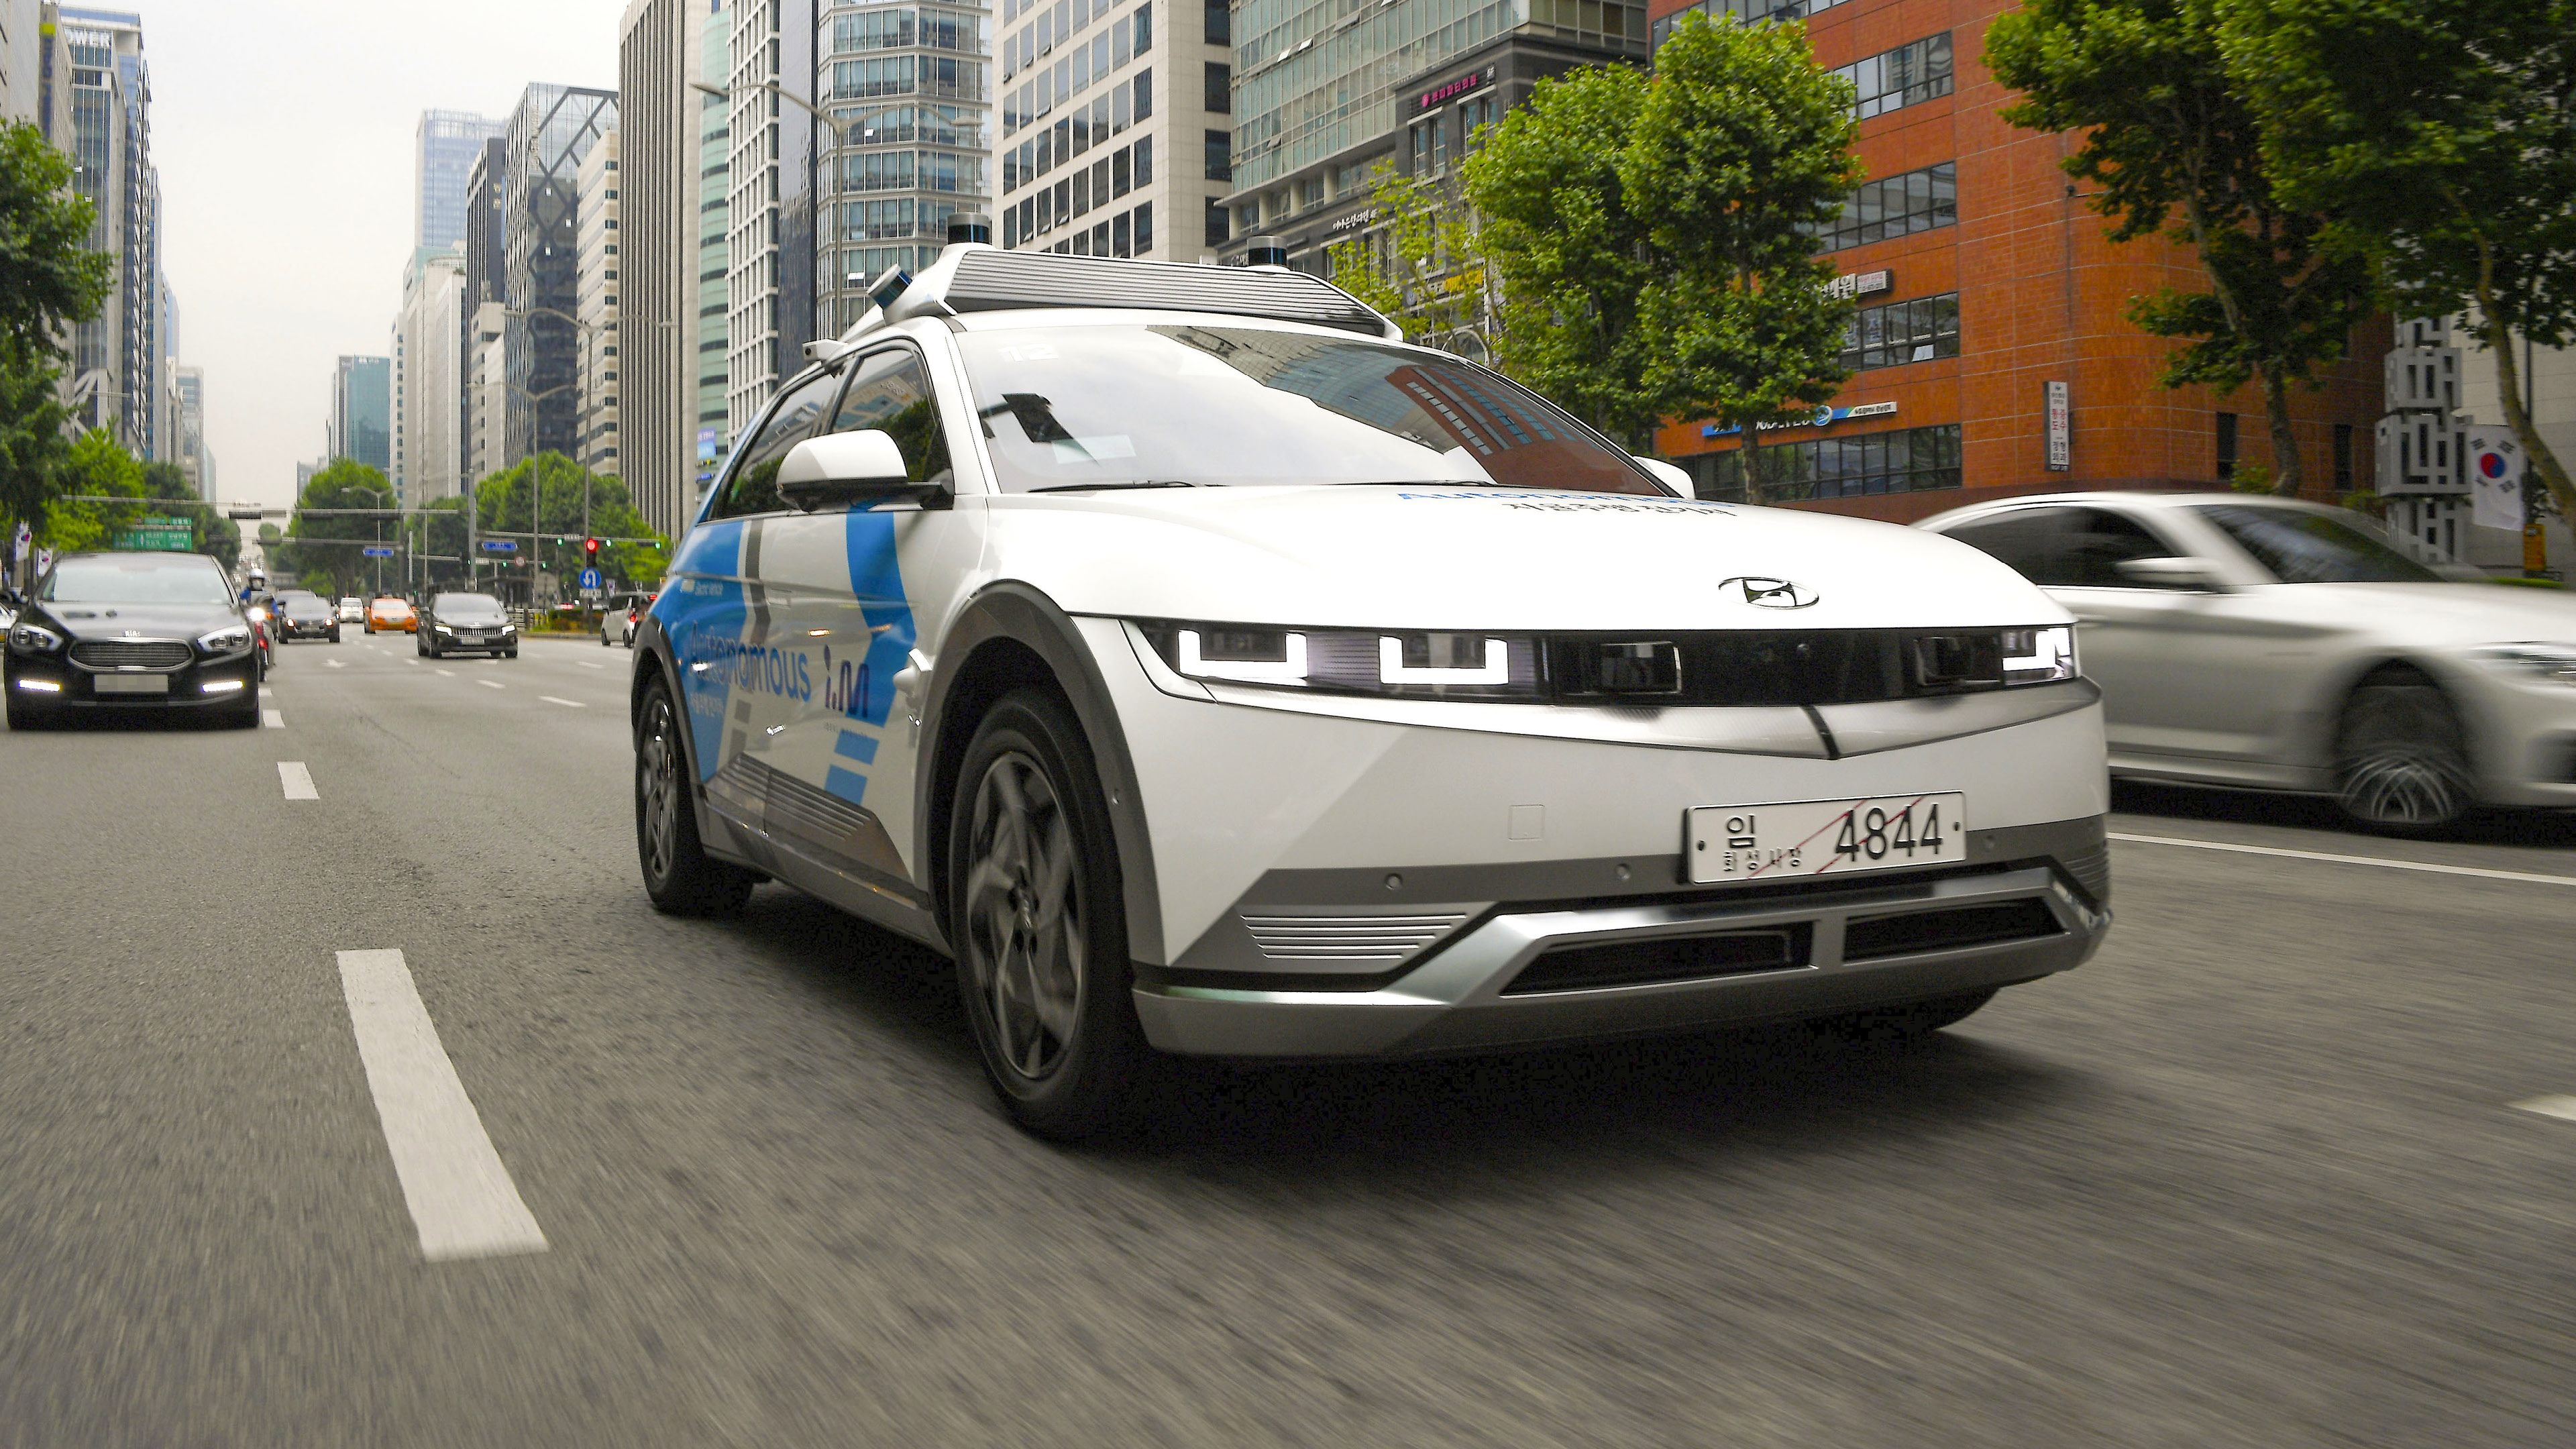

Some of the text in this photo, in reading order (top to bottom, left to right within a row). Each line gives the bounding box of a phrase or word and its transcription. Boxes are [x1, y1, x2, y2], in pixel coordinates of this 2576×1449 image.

[65, 29, 111, 48] OWER
[1726, 814, 1756, 849] 임
[1835, 803, 1943, 862] 4844
[1723, 847, 1802, 871] 화성시장
